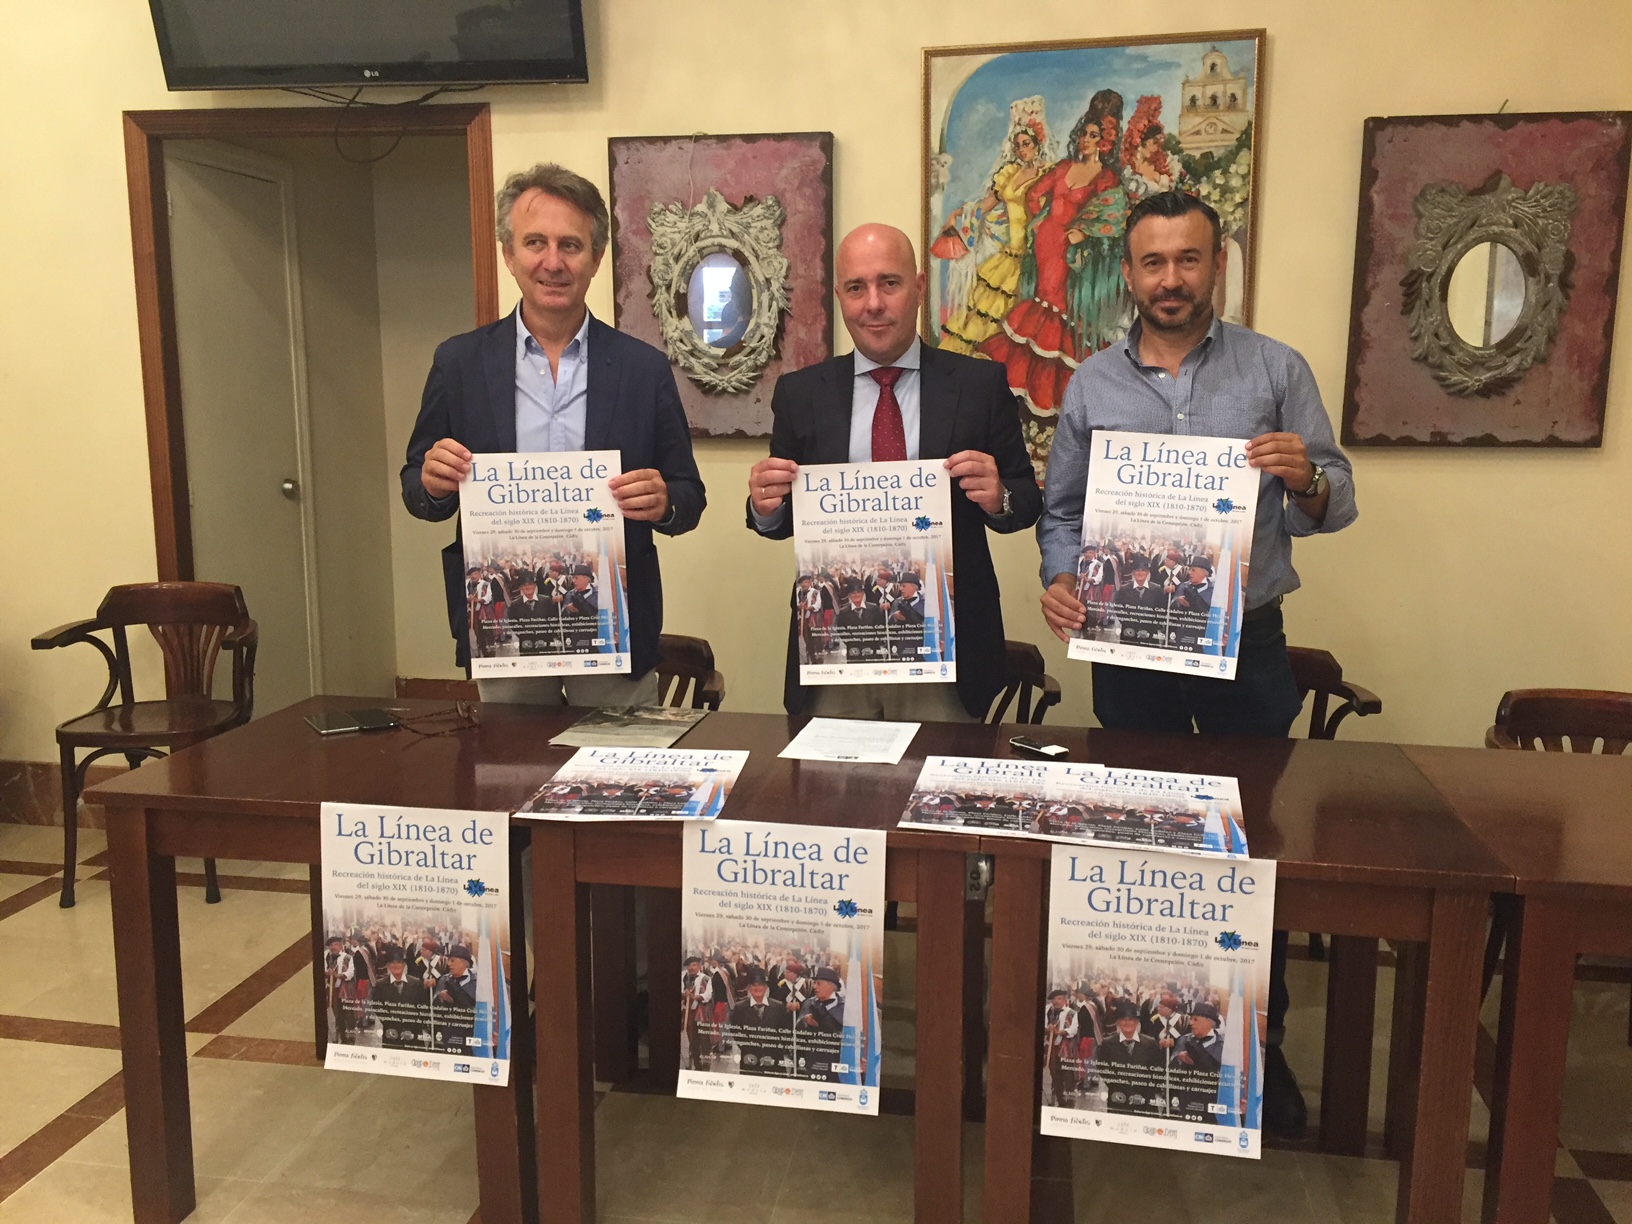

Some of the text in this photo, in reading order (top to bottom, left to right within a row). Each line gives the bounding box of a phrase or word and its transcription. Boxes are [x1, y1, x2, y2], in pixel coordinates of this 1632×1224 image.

[1103, 438, 1247, 468] La Línea de
[470, 458, 607, 482] La Línea de
[803, 466, 936, 492] La Línea de
[1116, 463, 1229, 491] Gibraltar
[487, 482, 594, 504] Gibraltar
[819, 491, 923, 513] Gibraltar
[1094, 488, 1132, 496] Recreación
[1134, 490, 1165, 499] histórica
[1162, 503, 1206, 513] (1810-1870)
[600, 757, 715, 766] Gibraltar
[628, 751, 694, 760] Línea
[1065, 768, 1222, 788] La Línea de
[1080, 776, 1204, 793] Gibraltar
[337, 812, 493, 845] La Línea de
[354, 840, 477, 870] Gibraltar
[699, 829, 867, 864] La Línea de
[333, 869, 374, 878] Recreación
[377, 871, 410, 880] histórica
[436, 876, 458, 884] Línea
[717, 858, 849, 890] Gibraltar
[1068, 855, 1255, 894] La Línea de
[371, 882, 390, 891] siglo
[409, 885, 457, 896] (1810-1870)
[693, 887, 738, 897] Recreación
[740, 890, 777, 900] histórica
[805, 895, 827, 904] Línea
[734, 901, 754, 910] siglo
[756, 902, 772, 910] XIX
[775, 904, 827, 916] (1810-1870)
[1087, 886, 1233, 921] Gibraltar
[1060, 917, 1208, 936] Recreación histórica de La Línea
[1088, 930, 1207, 948] del siglo XIX (1810-1870)
